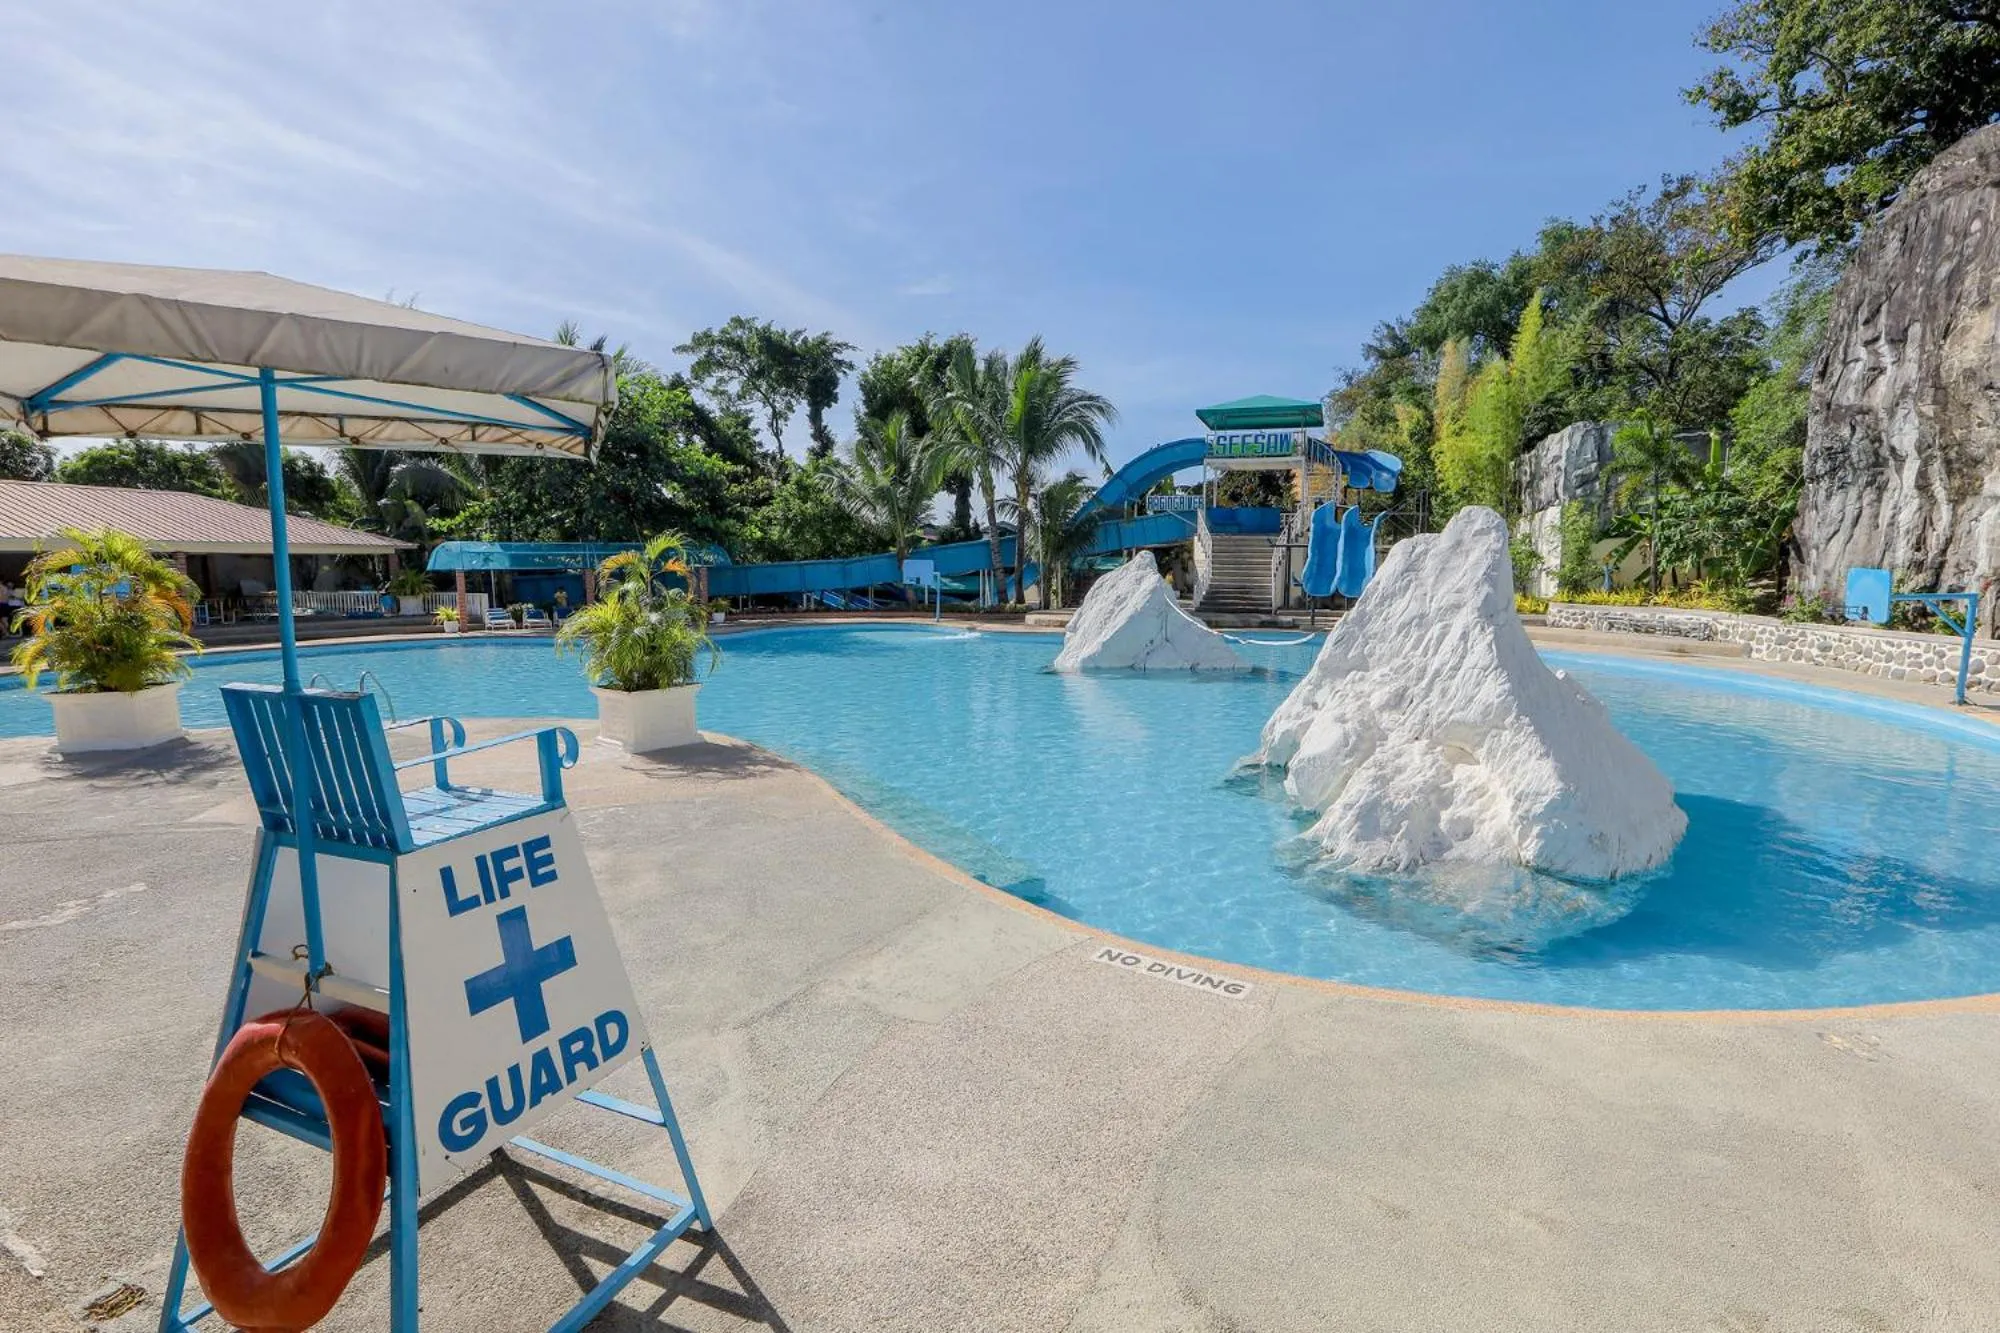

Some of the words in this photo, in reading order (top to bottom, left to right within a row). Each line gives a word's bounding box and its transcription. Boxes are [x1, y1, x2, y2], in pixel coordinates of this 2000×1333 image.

[439, 835, 558, 918] LIFE
[1098, 949, 1141, 966] NO
[1146, 962, 1246, 994] DIVING
[438, 1010, 630, 1153] GUARD
